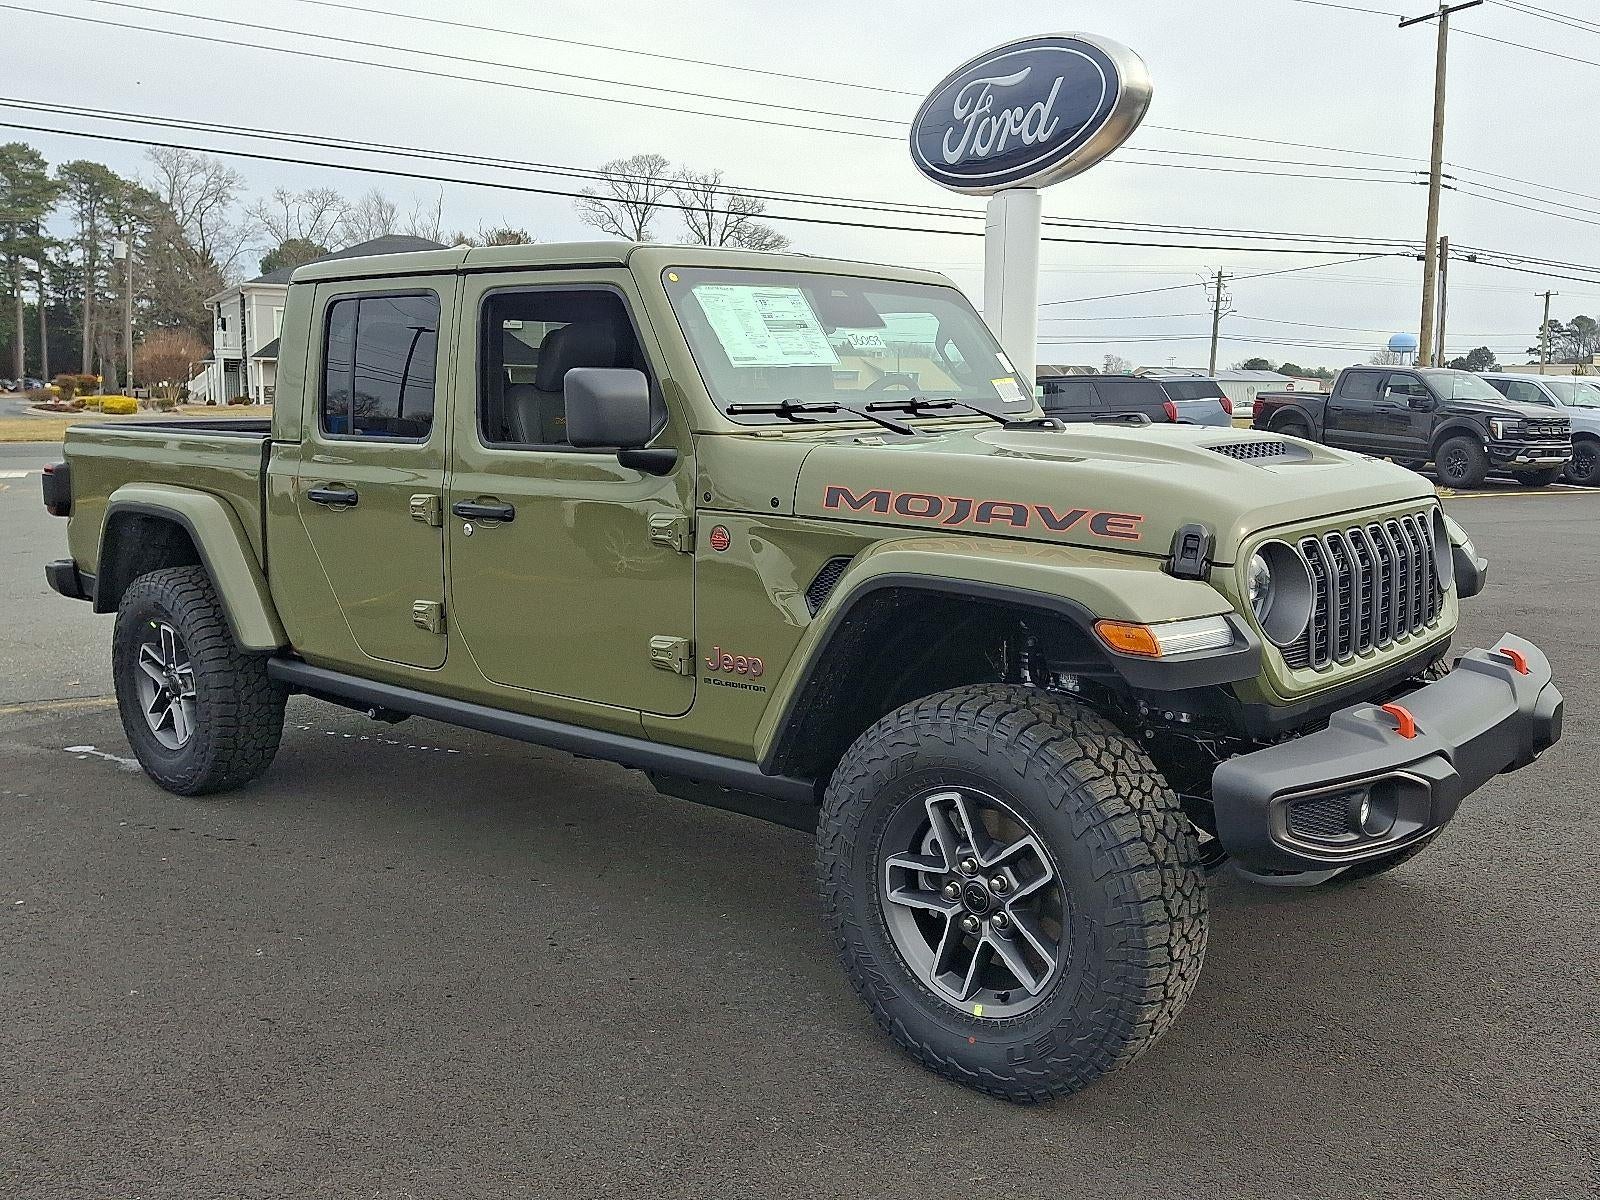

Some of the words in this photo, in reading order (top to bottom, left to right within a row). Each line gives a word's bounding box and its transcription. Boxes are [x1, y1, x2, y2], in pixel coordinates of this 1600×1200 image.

[942, 66, 1065, 164] Ford
[823, 485, 1144, 540] MOJAVE
[704, 646, 764, 682] Jeep
[712, 678, 767, 694] GLADIATOR
